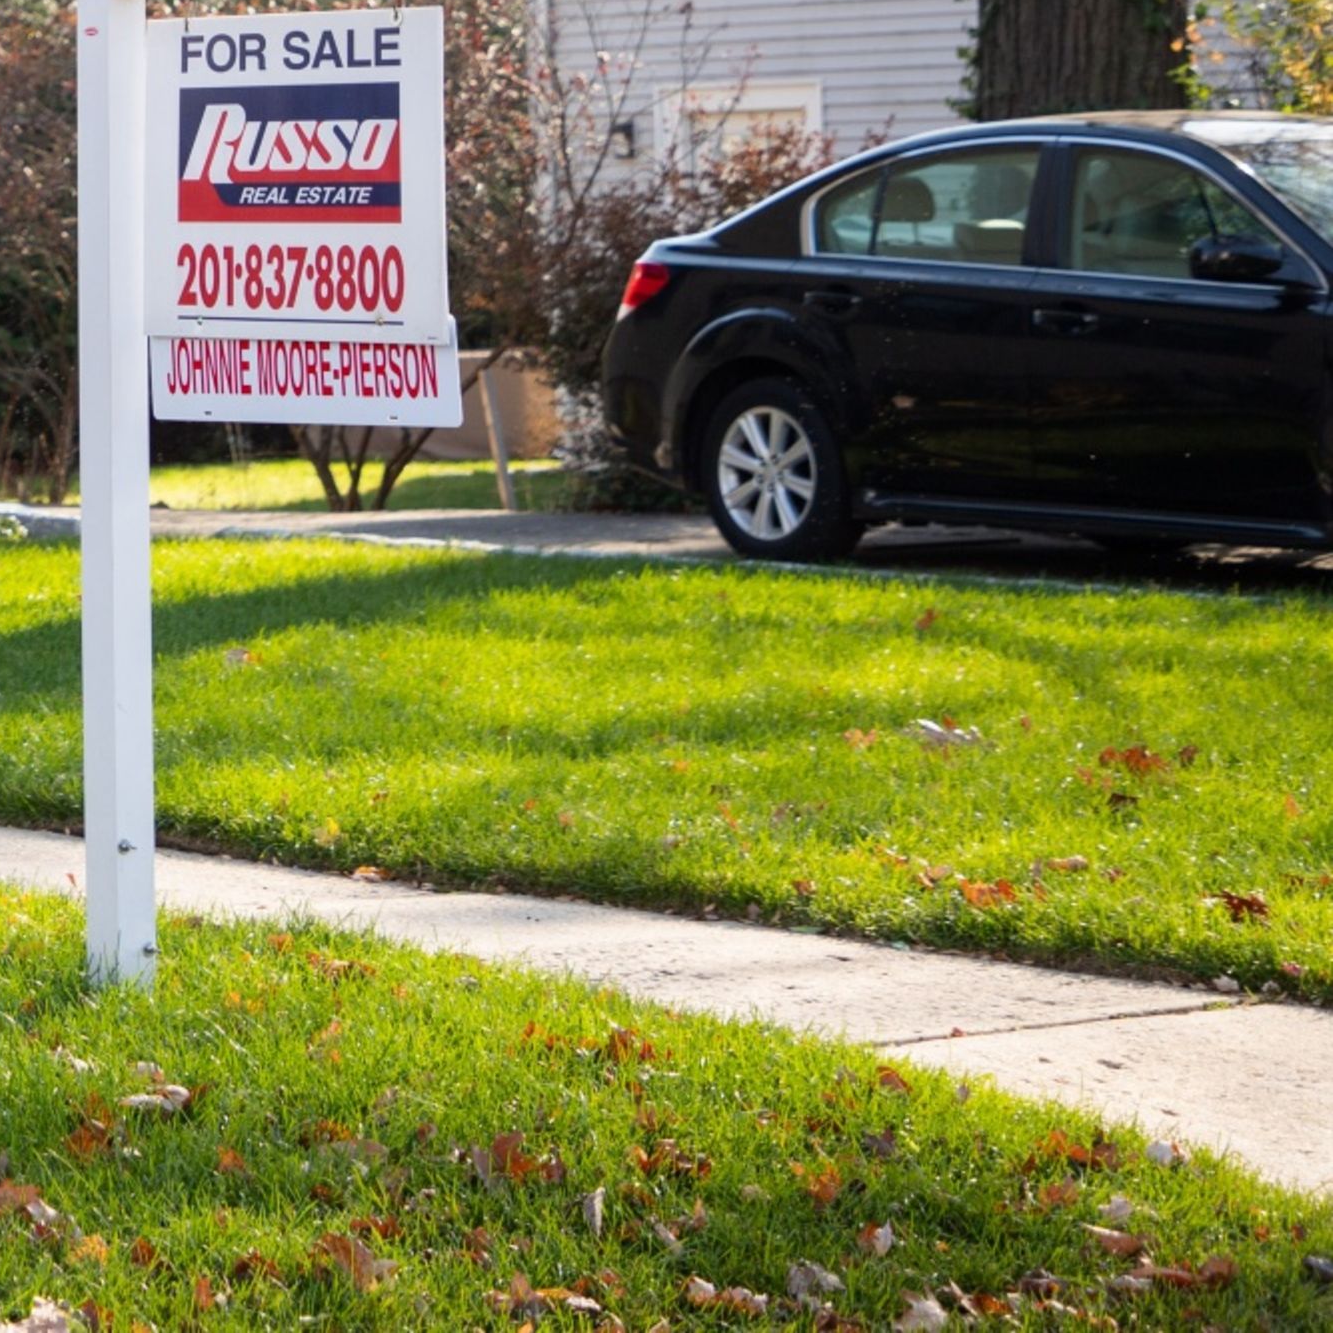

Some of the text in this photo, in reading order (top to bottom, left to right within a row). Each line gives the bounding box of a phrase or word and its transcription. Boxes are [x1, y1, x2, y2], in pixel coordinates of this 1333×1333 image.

[180, 28, 402, 73] FOR SALE
[182, 104, 399, 185] RUSSO
[239, 185, 373, 205] REAL ESTATE
[166, 338, 439, 399] JOHNNIE MOORE-PIERSON
